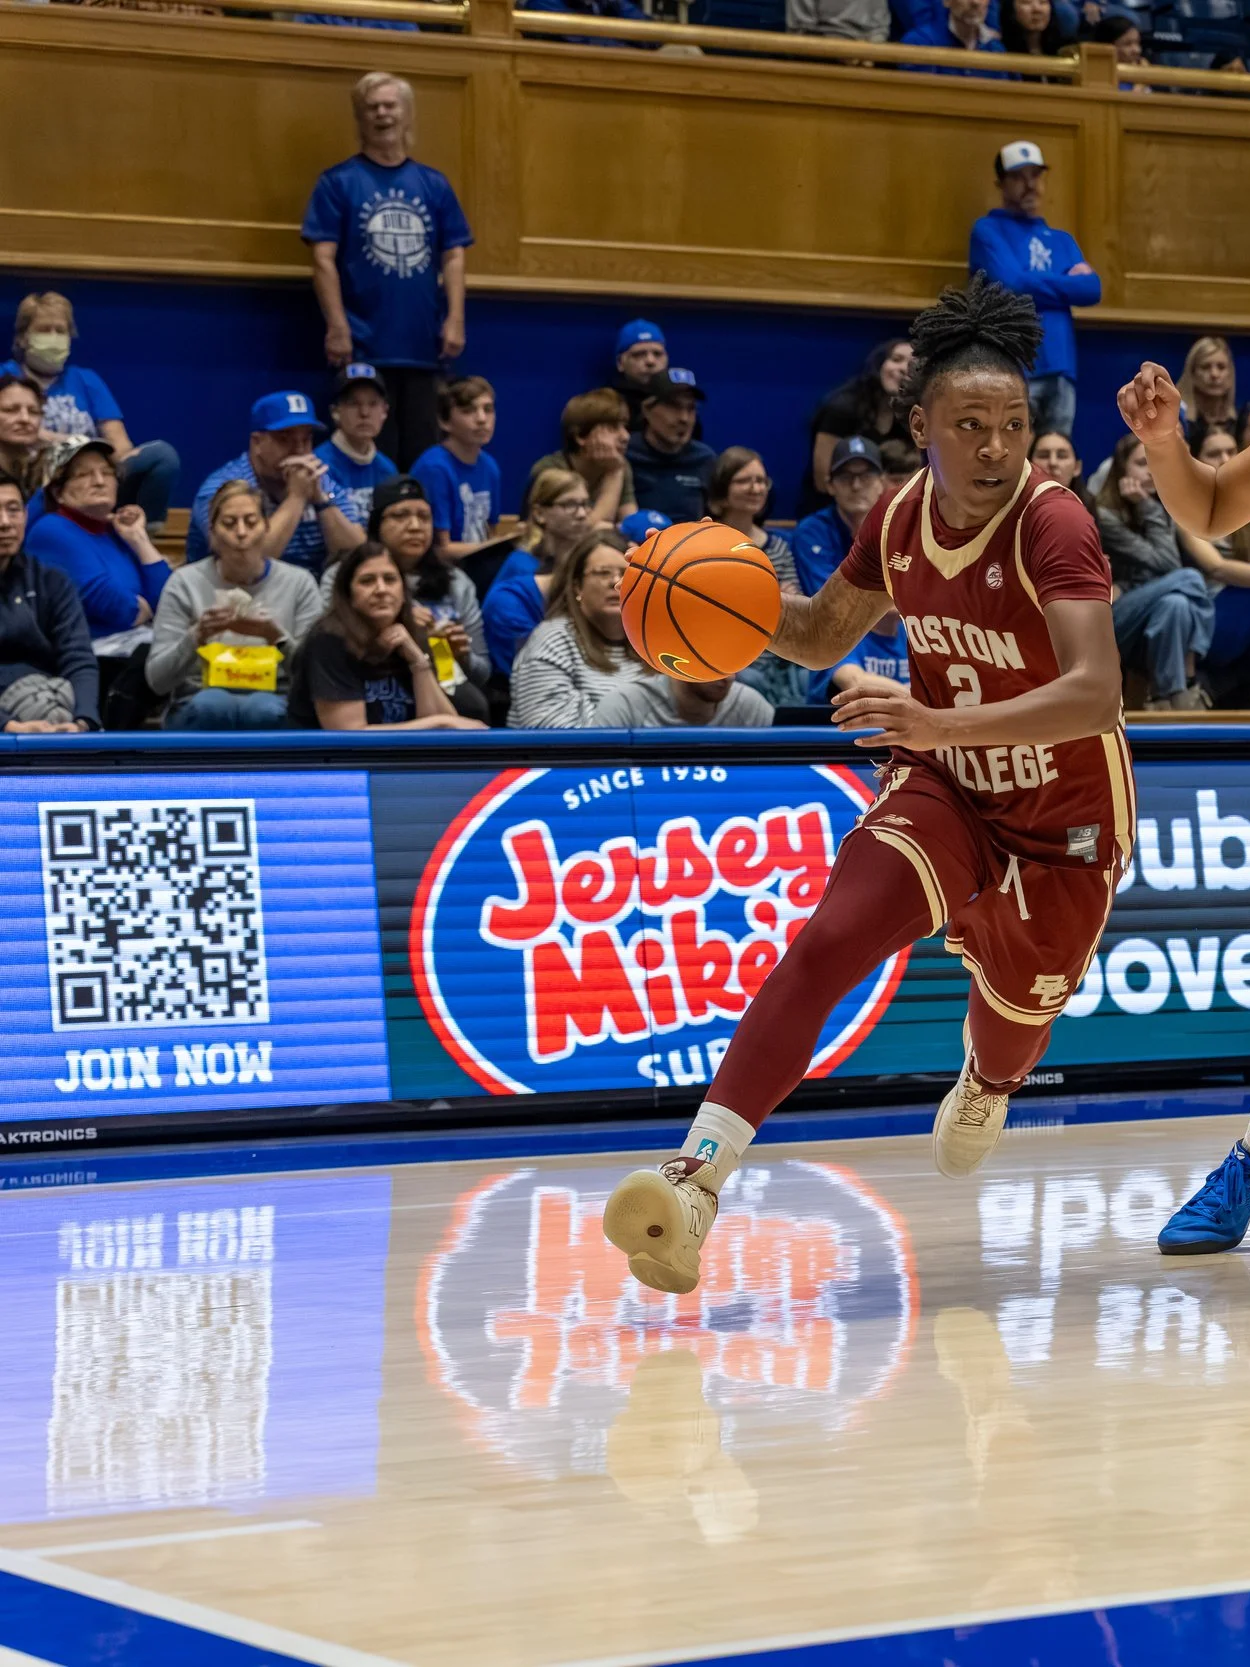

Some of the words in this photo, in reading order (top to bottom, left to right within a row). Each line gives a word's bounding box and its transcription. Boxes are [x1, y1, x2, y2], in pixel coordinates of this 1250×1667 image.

[905, 616, 1026, 670] OSTON
[946, 664, 982, 708] 2
[562, 766, 646, 811] SINCE
[935, 744, 1060, 794] OLLEGE
[483, 804, 832, 944] Jersey
[527, 900, 810, 1062] Mike'
[55, 1046, 162, 1093] JOIN
[173, 1041, 273, 1086] NOW
[0, 1127, 97, 1145] AKTRONICS
